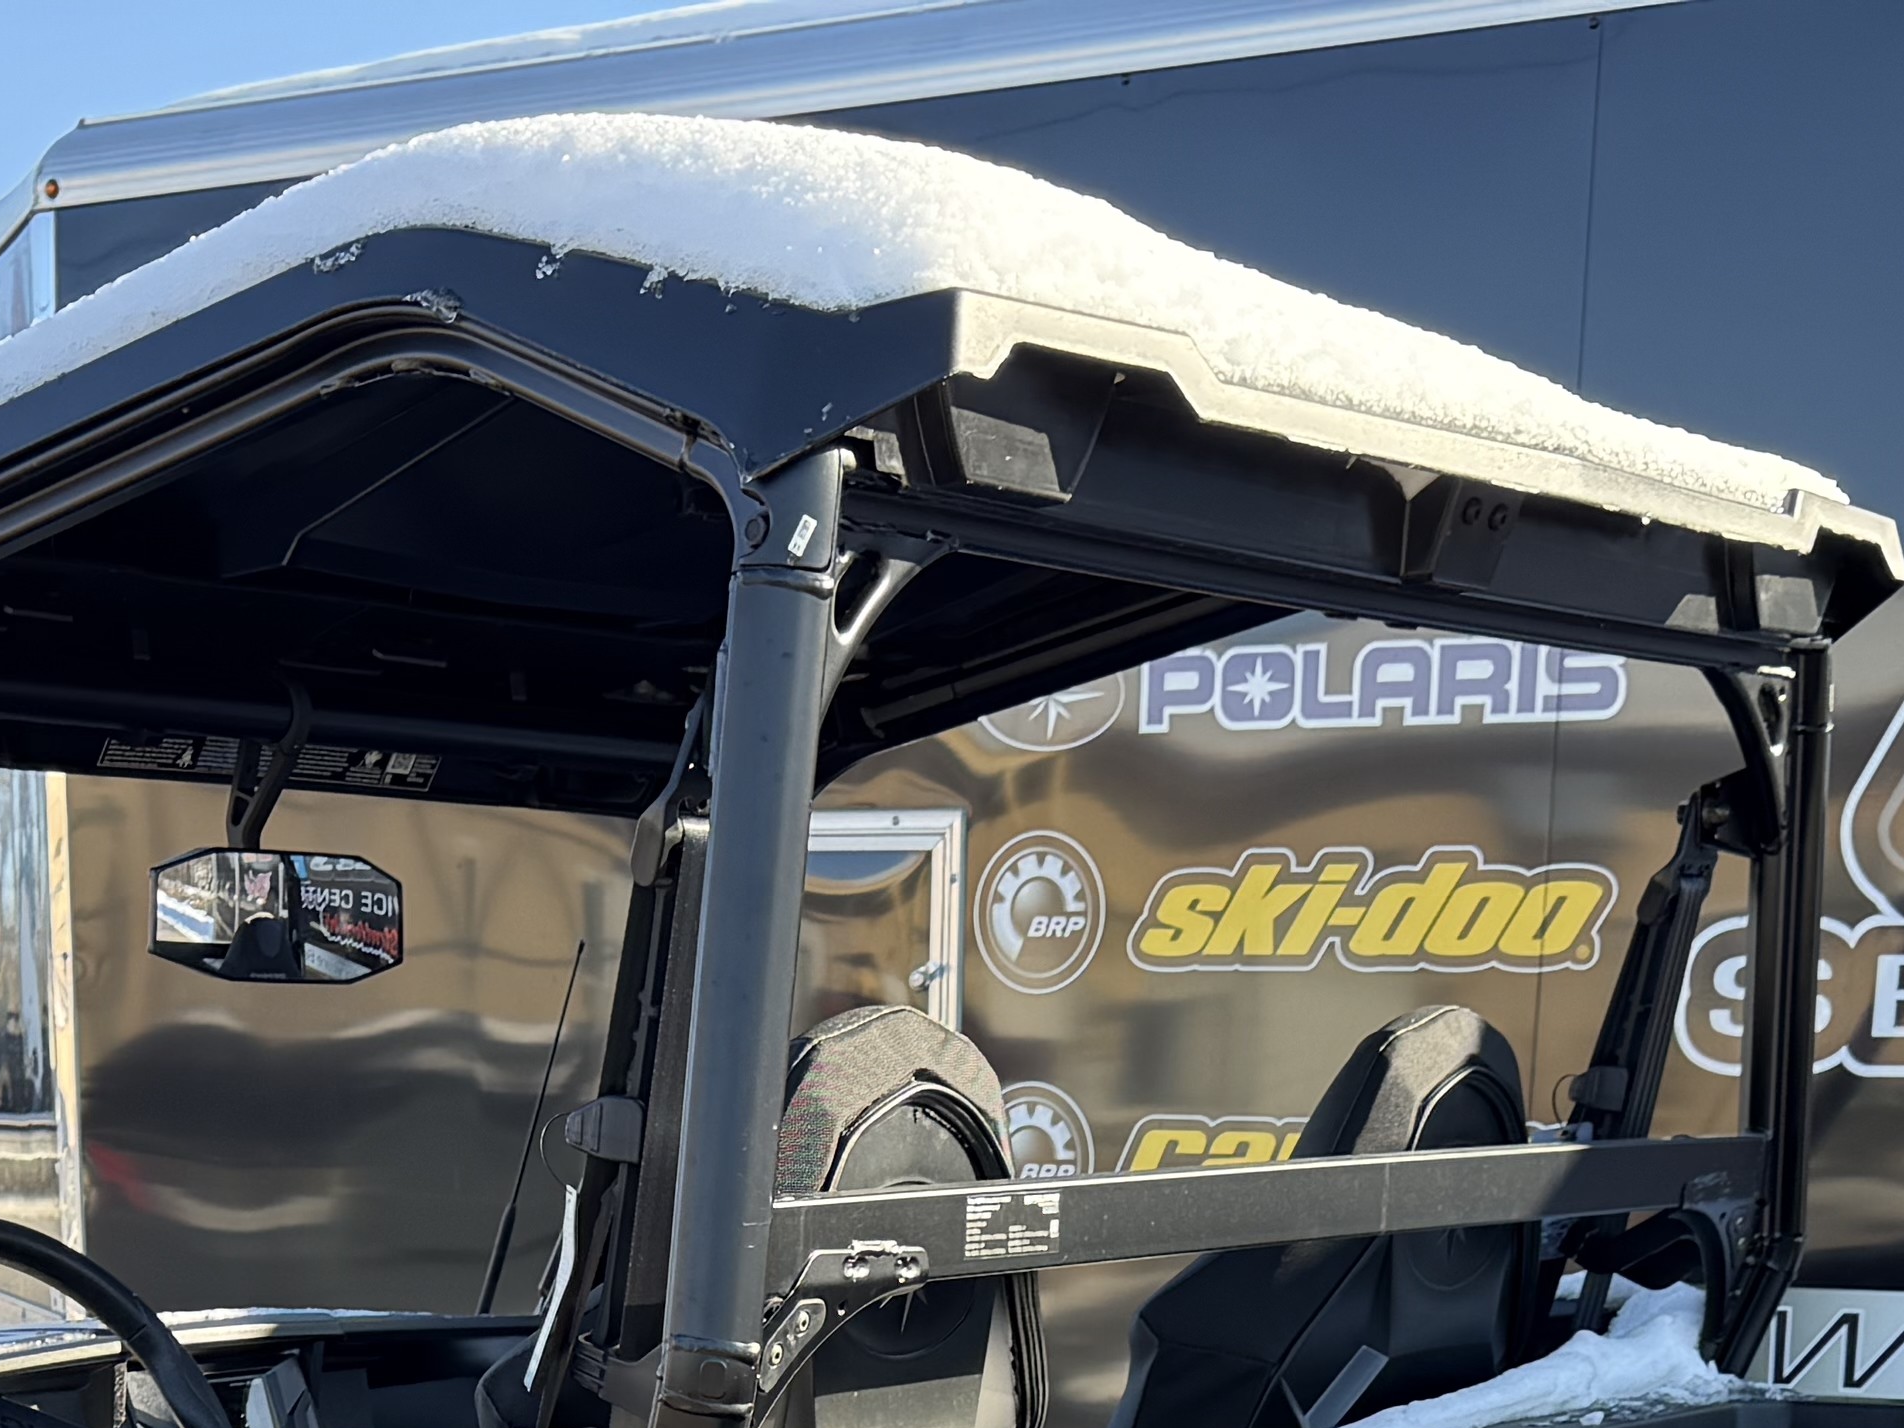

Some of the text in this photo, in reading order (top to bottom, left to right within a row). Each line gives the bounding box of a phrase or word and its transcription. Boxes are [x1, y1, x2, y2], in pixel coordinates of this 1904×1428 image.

[1138, 637, 1627, 734] POLARIS
[1027, 915, 1086, 940] BRP
[1139, 861, 1606, 958] ski-doo
